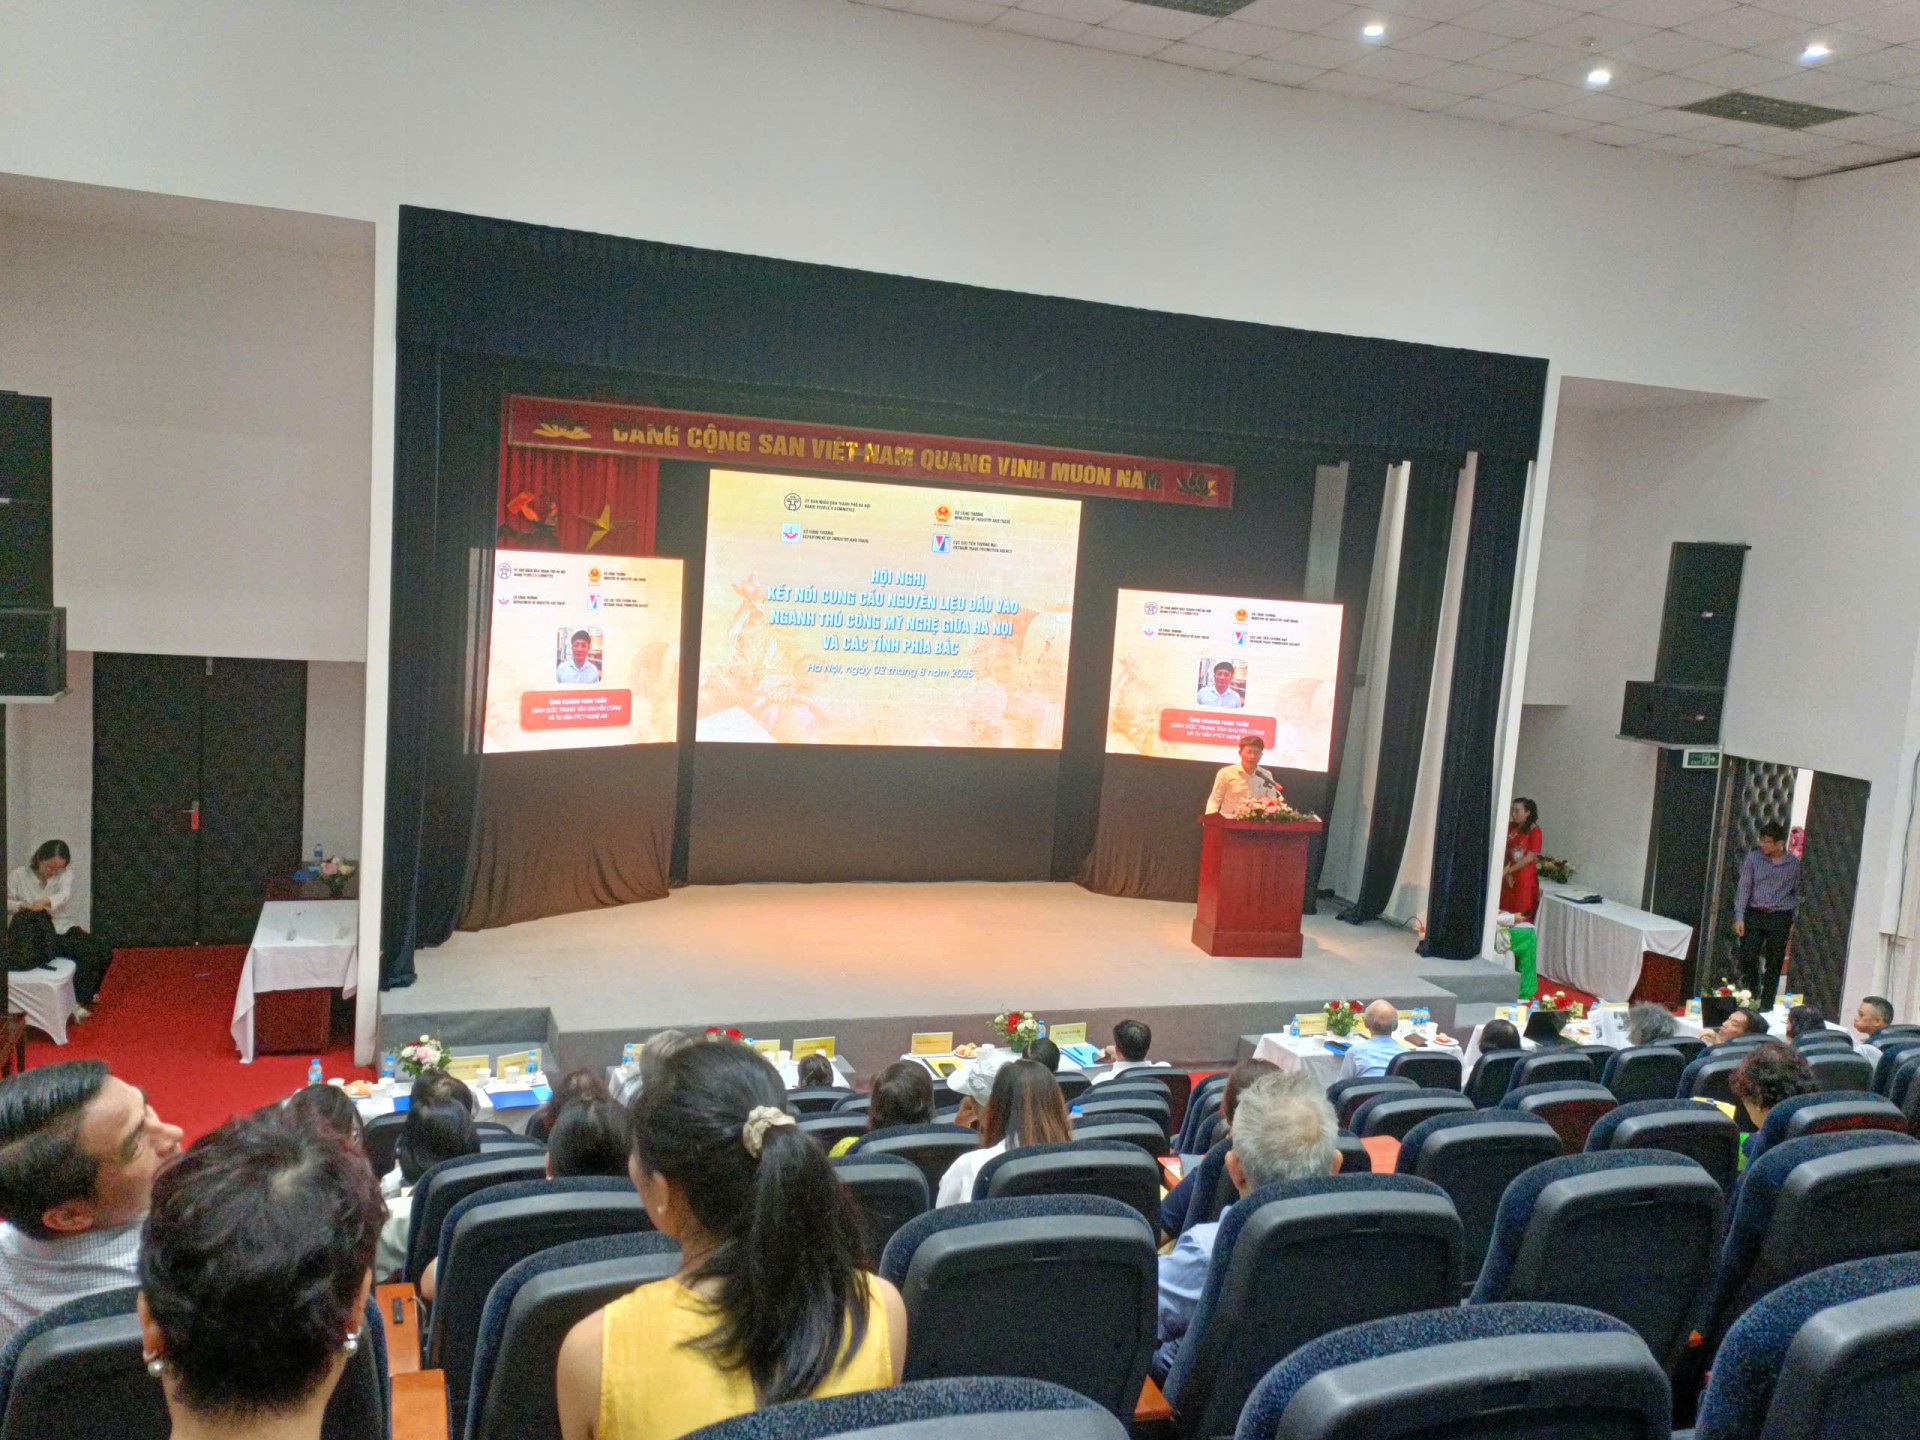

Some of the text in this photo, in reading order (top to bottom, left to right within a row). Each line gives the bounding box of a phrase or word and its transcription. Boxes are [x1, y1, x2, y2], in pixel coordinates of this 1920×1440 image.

[687, 423, 750, 453] CỘNG
[812, 436, 858, 464] VIỆT
[864, 442, 914, 467] NAM
[920, 448, 991, 474] QUANG
[998, 457, 1045, 479] VINH
[871, 568, 926, 590] HỘI NGHỊ
[767, 584, 792, 602] KẾT
[794, 584, 818, 604] NỐI
[820, 588, 856, 606] CUNG
[887, 592, 937, 610] NGUYÊN
[939, 595, 966, 614] LIỆU
[996, 597, 1020, 615] VÀO
[770, 609, 816, 627] NGÀNH
[819, 610, 844, 628] THỦ
[846, 613, 881, 630] CÔNG
[884, 614, 903, 631] MỸ
[906, 616, 939, 636] NGHỆ
[941, 618, 970, 635] GIỮA
[992, 620, 1013, 639] NỘI
[823, 634, 839, 651] VÀ
[842, 635, 869, 652] CÁC
[903, 638, 931, 655] PHÍA
[934, 638, 959, 656] BẮC
